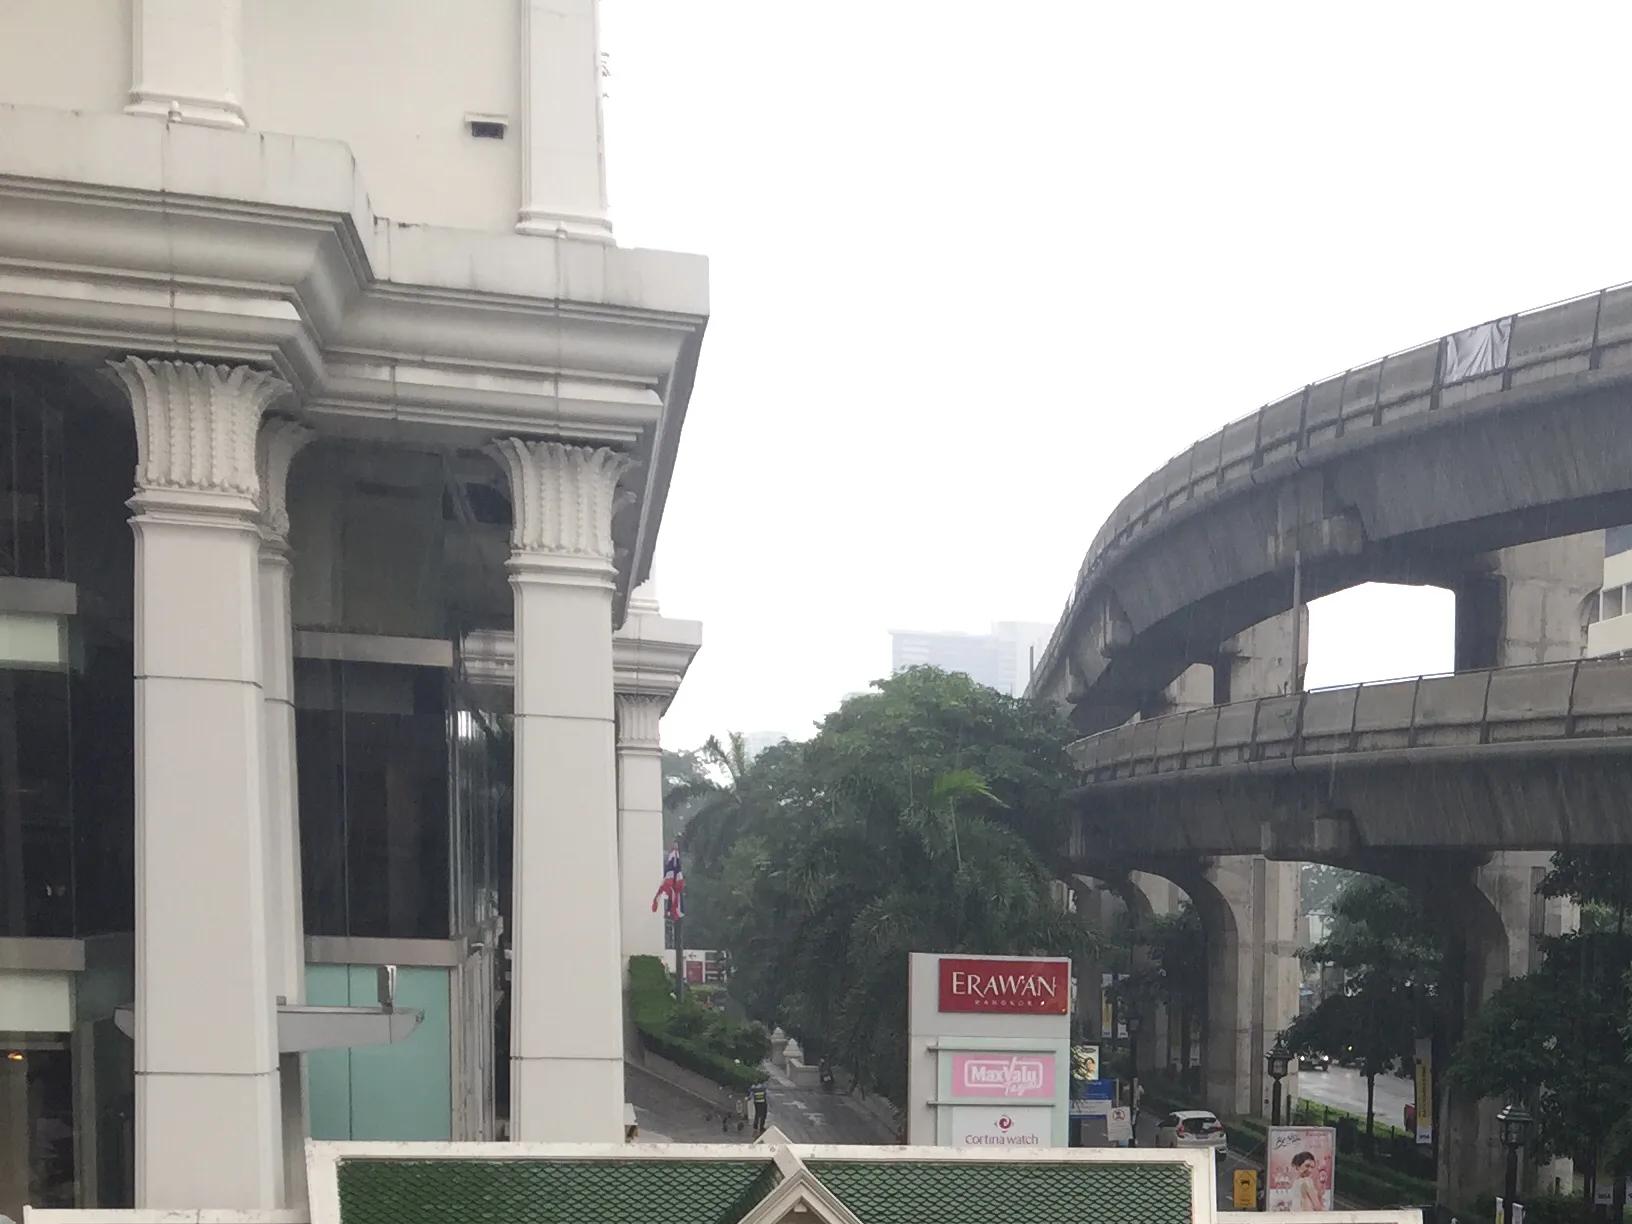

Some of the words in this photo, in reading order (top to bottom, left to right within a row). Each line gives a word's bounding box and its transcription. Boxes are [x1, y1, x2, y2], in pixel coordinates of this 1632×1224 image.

[952, 971, 1056, 997] ERAWAN
[971, 1056, 1037, 1084] MaxValu
[1006, 1134, 1039, 1145] watch
